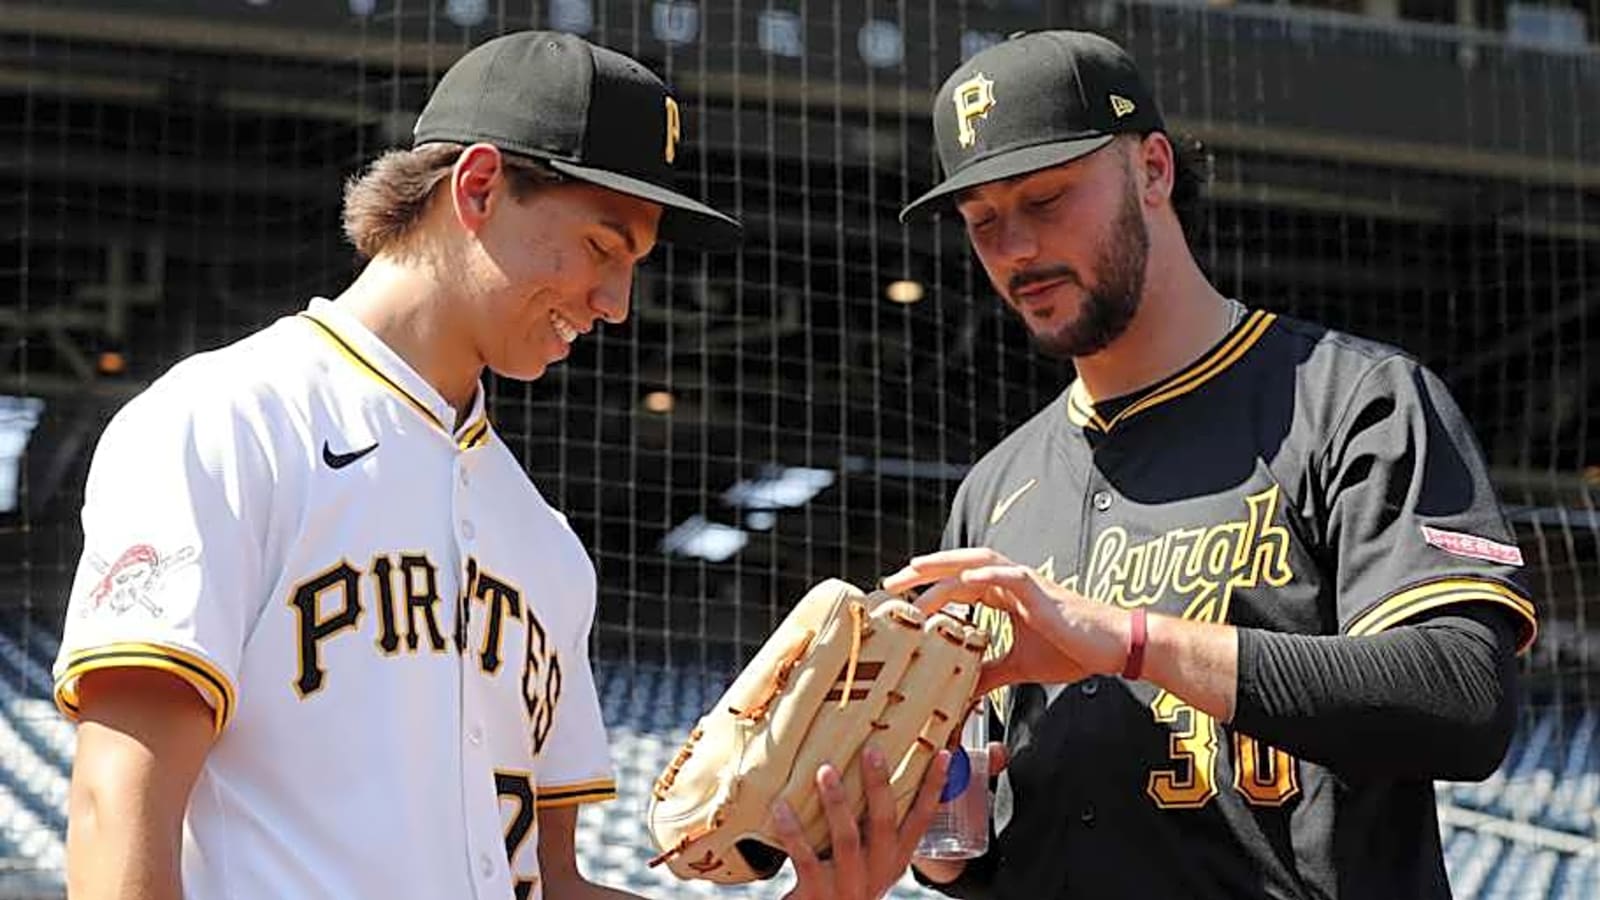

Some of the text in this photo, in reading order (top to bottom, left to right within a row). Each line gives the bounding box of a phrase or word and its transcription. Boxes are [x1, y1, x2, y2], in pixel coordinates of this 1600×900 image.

[665, 95, 681, 165] P
[952, 71, 997, 150] P
[286, 548, 562, 760] PIRATES
[1147, 688, 1300, 809] 30
